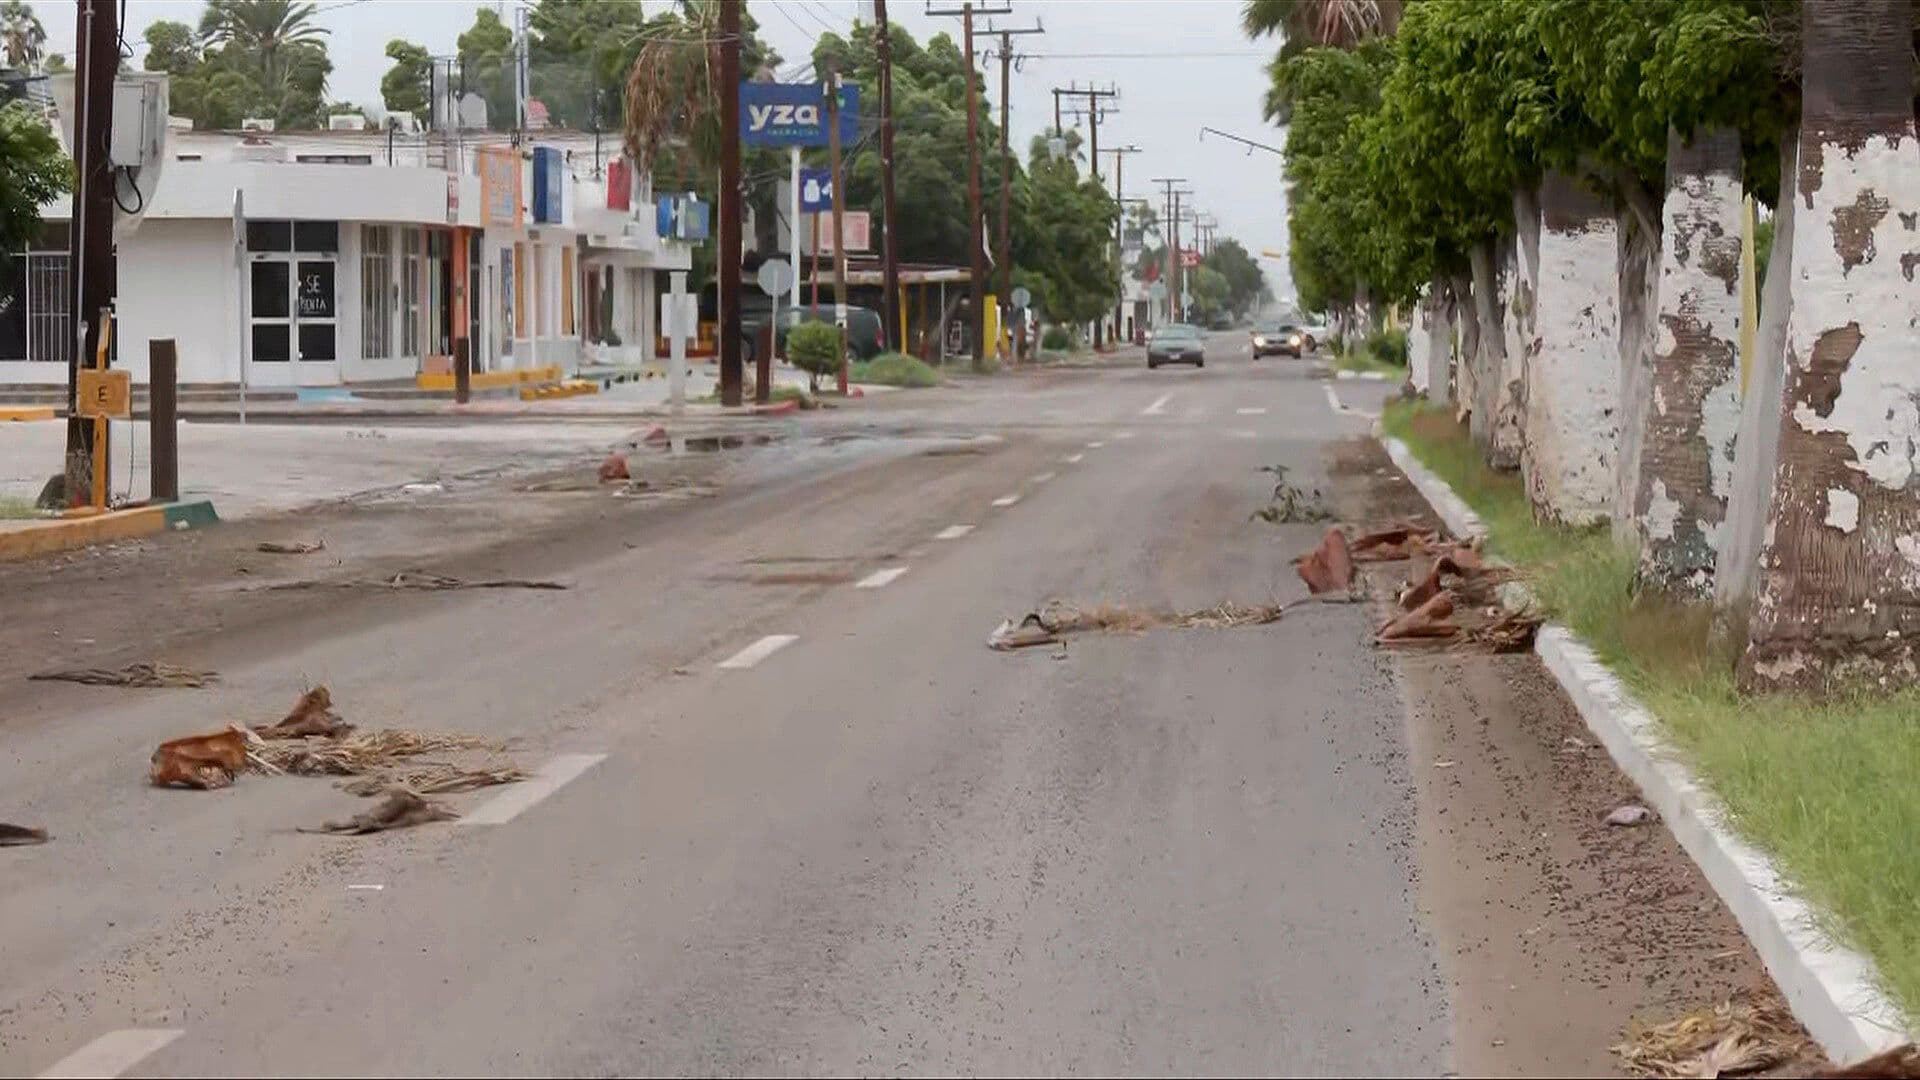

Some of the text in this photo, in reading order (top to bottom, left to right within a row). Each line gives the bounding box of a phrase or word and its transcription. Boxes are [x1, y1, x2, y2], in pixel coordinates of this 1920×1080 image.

[748, 105, 818, 132] yza
[306, 273, 320, 292] SE
[98, 386, 107, 402] E
